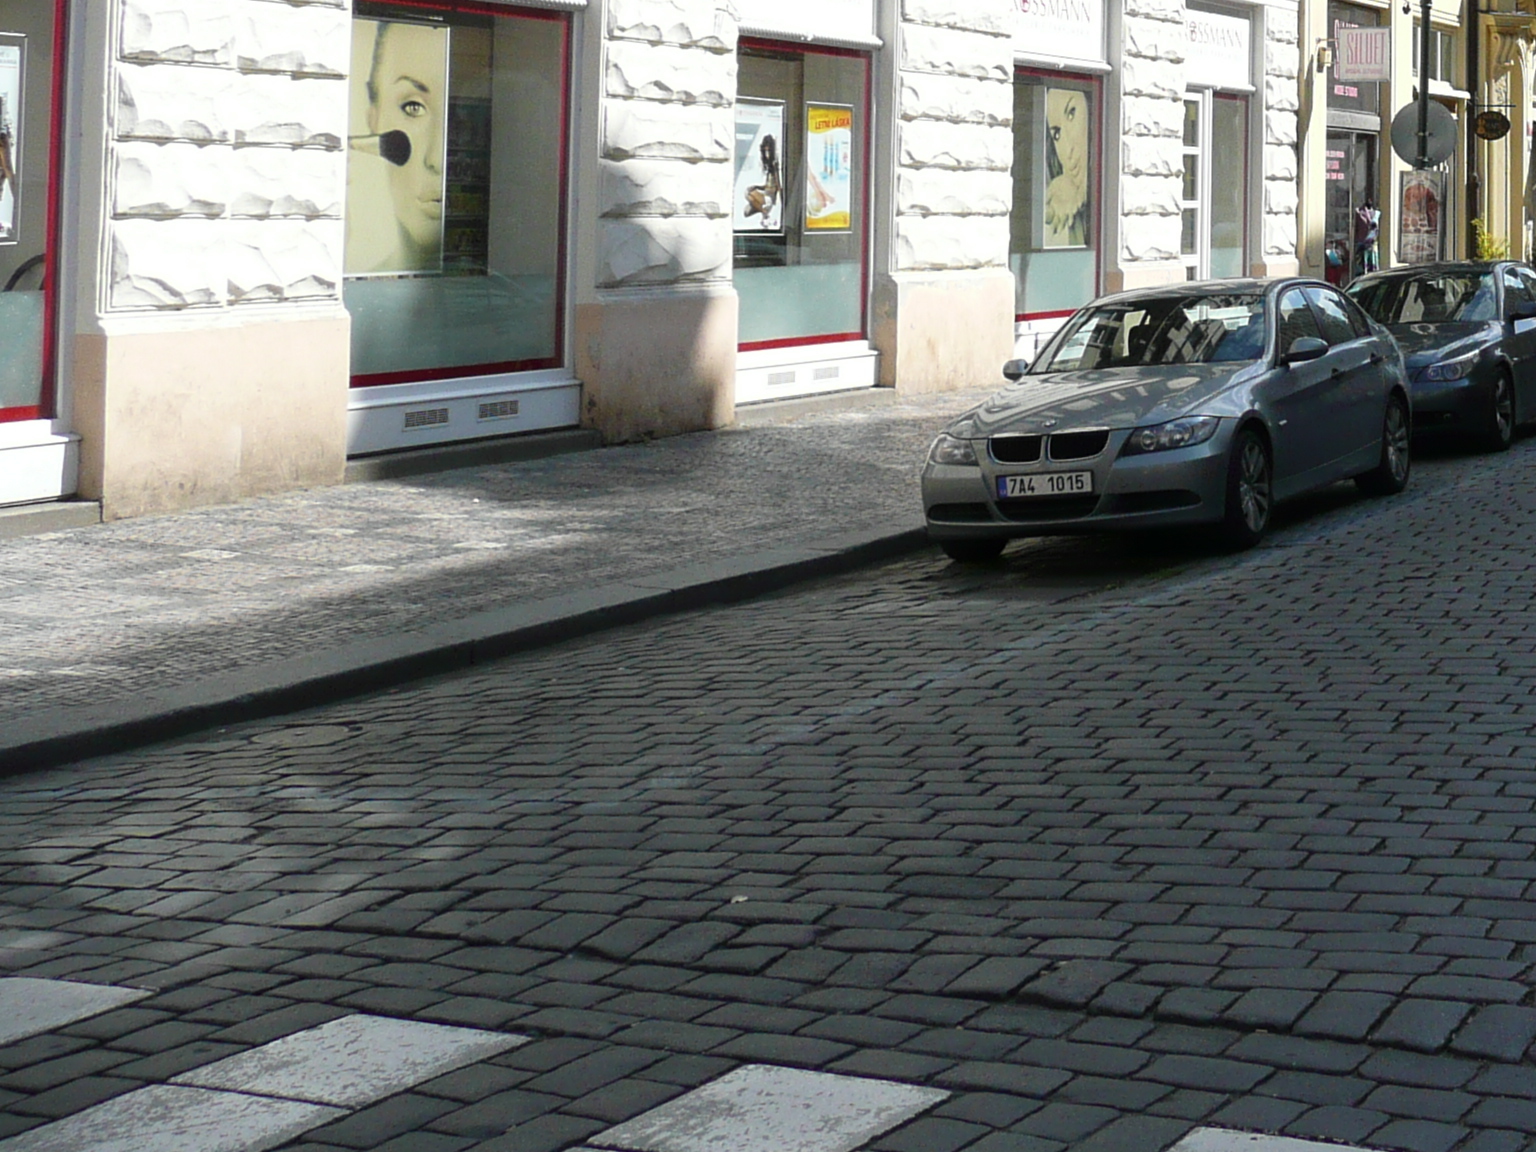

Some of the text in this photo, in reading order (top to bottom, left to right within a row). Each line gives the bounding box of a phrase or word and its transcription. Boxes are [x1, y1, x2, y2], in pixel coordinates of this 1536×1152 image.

[1346, 32, 1386, 65] SILUET
[1009, 478, 1036, 494] 7A4
[1047, 474, 1085, 492] 1015
